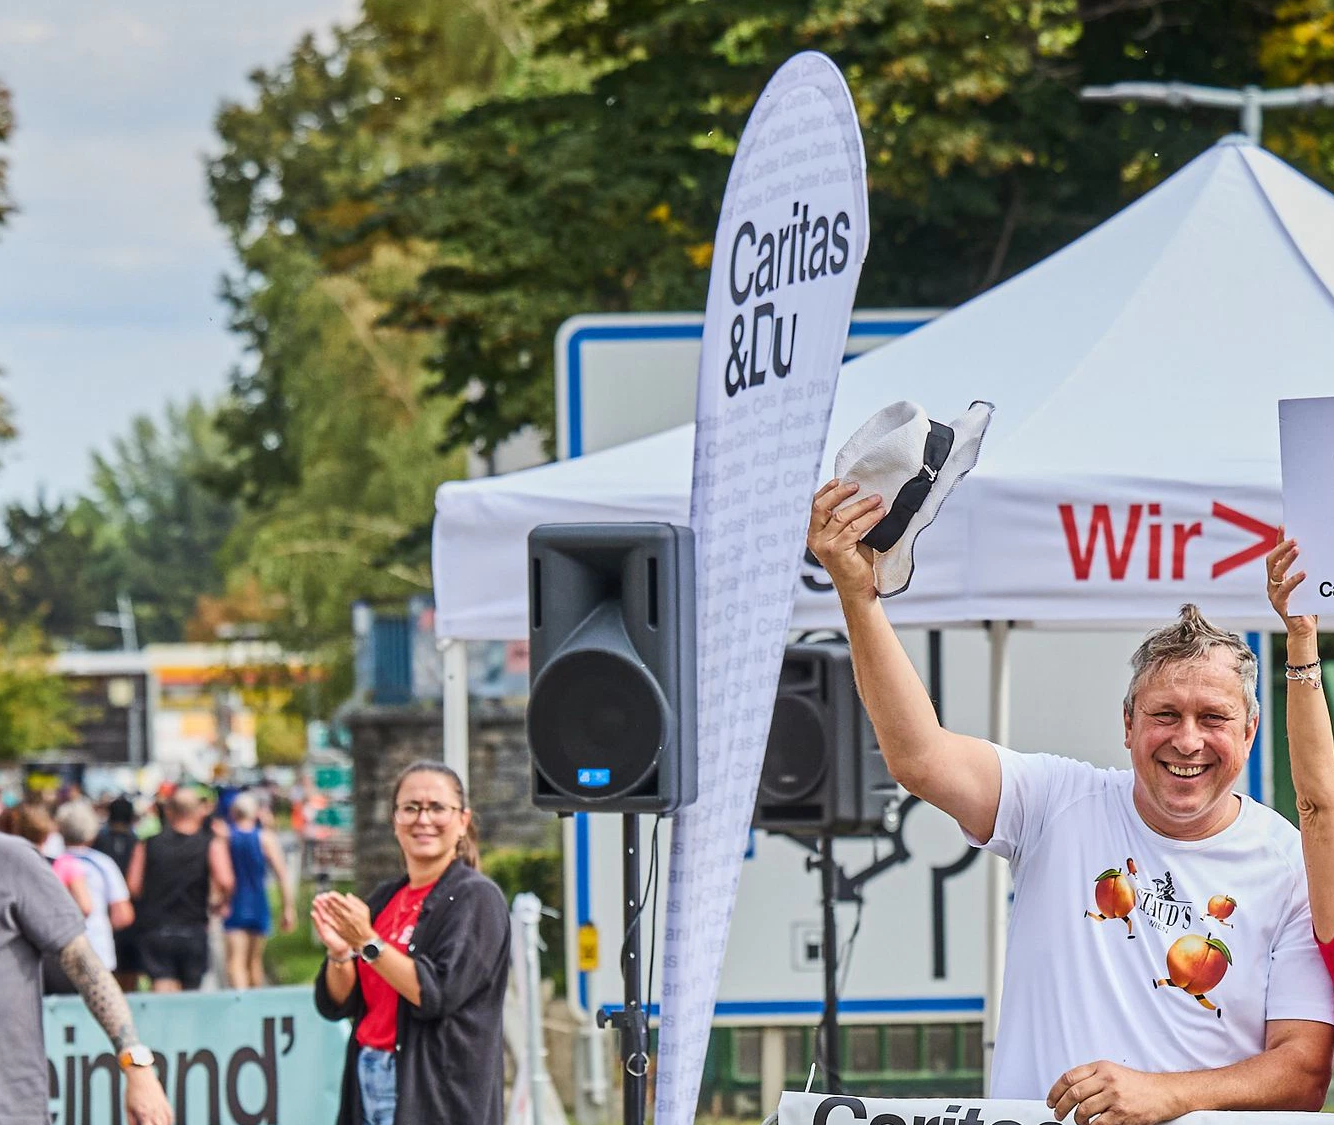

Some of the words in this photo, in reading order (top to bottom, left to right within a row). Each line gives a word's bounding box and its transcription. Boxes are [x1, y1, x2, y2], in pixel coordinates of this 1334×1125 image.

[729, 200, 851, 307] Caritas
[724, 301, 798, 398] &Du
[1136, 887, 1193, 930] STAUD'S
